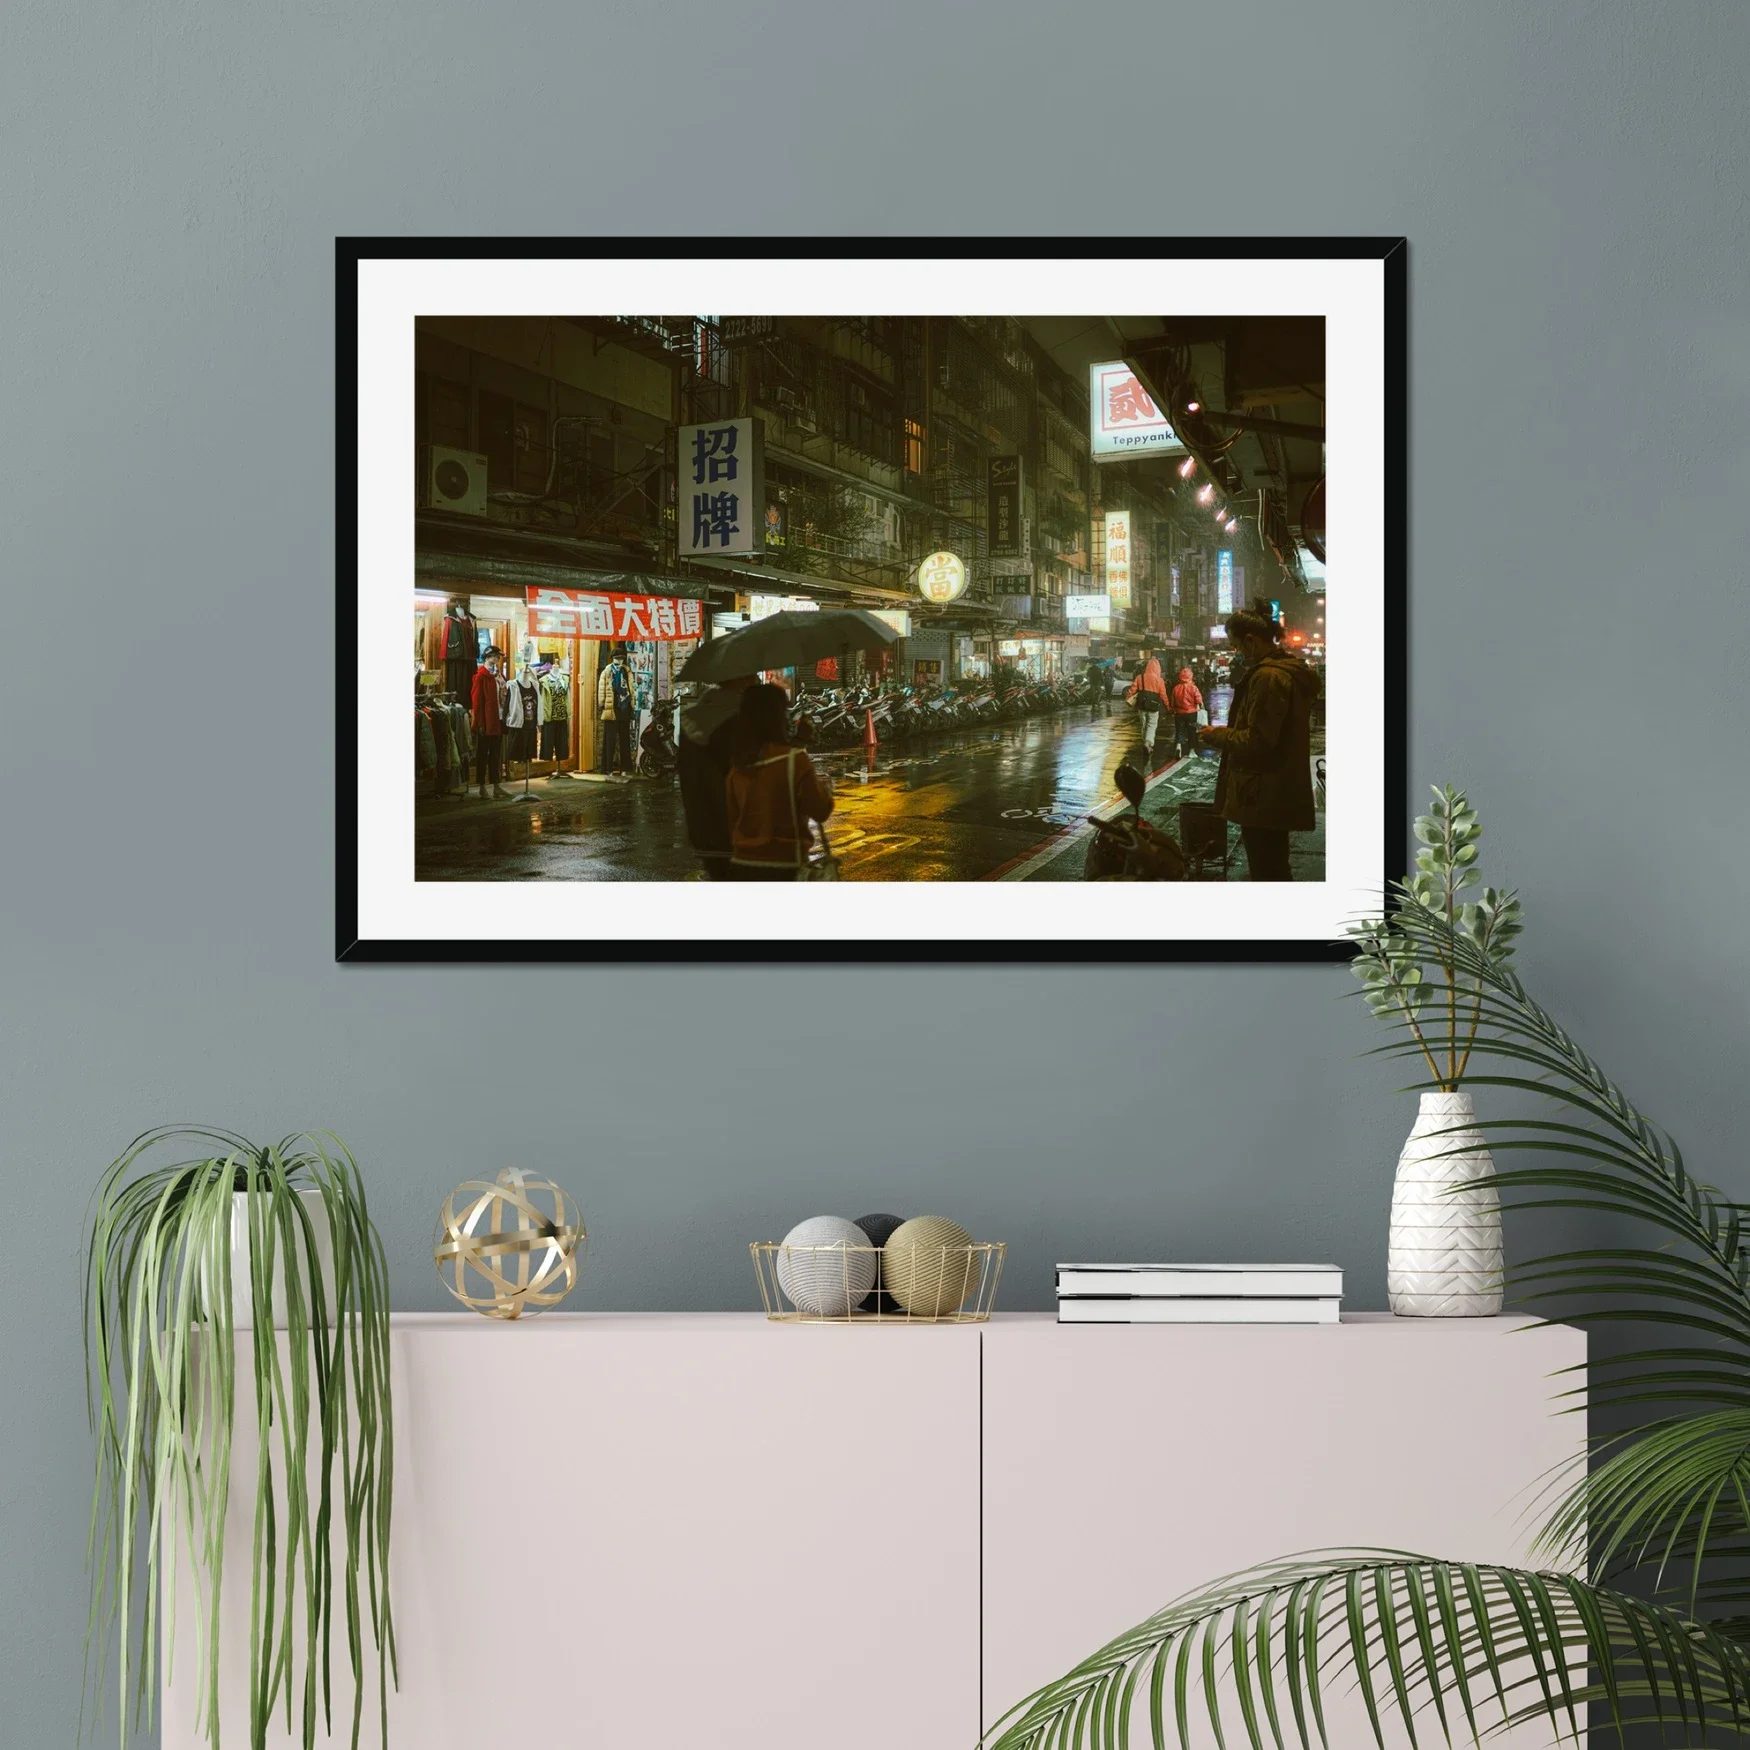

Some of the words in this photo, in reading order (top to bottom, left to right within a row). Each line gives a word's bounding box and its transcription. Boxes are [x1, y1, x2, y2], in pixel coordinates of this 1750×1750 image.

[692, 425, 740, 549] 招牌
[1108, 521, 1127, 564] 福順
[925, 555, 958, 597] 當
[536, 588, 700, 637] 全面大特價
